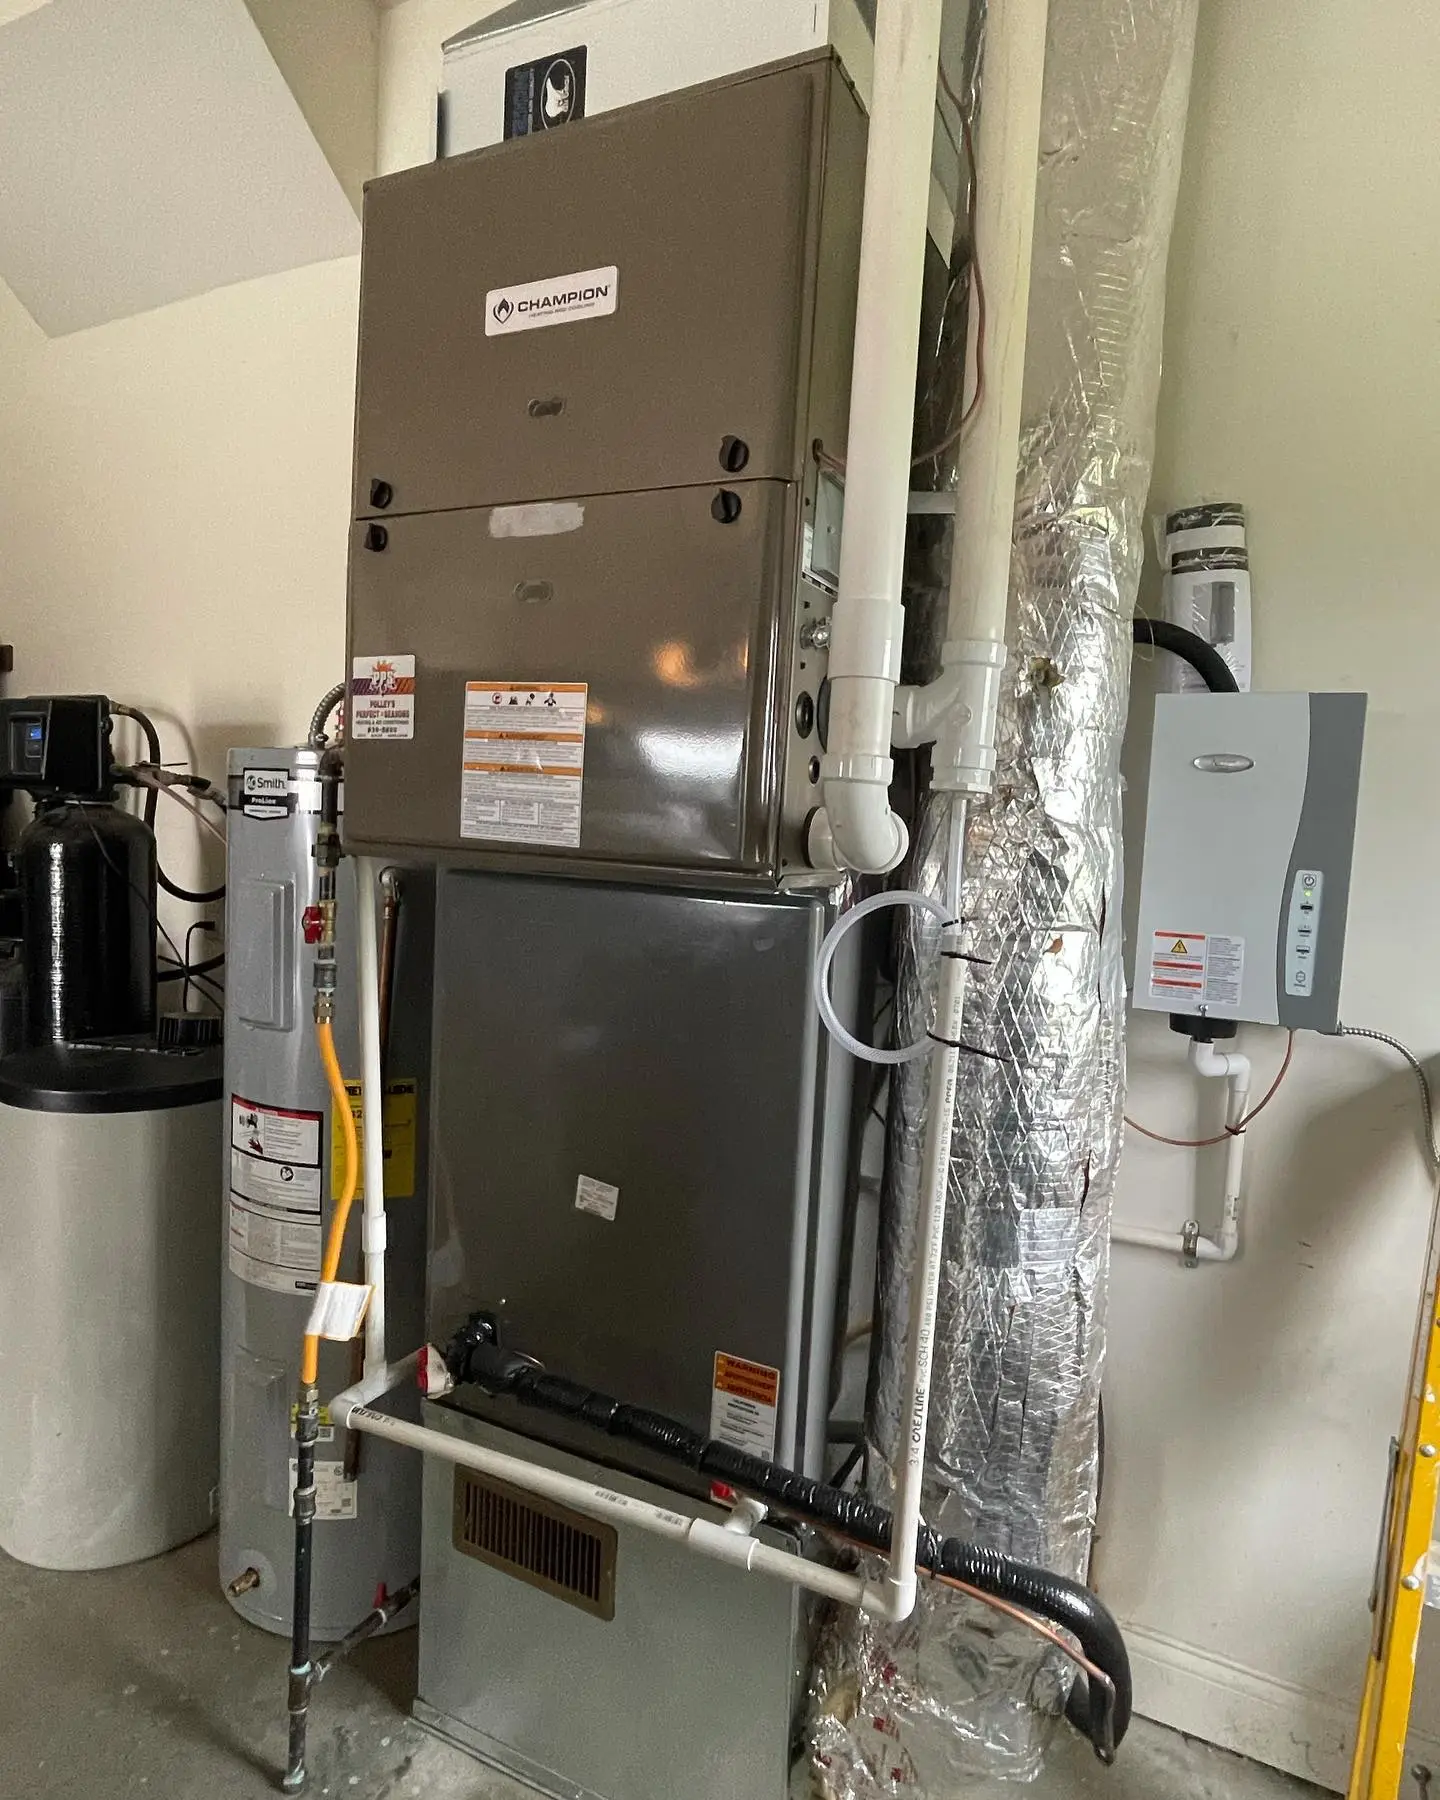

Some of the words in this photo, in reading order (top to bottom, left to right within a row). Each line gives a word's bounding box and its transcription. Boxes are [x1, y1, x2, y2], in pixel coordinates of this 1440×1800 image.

[518, 285, 608, 312] CHAMPION
[257, 777, 286, 789] Smith
[920, 1329, 930, 1343] 40
[918, 1346, 928, 1367] SCH
